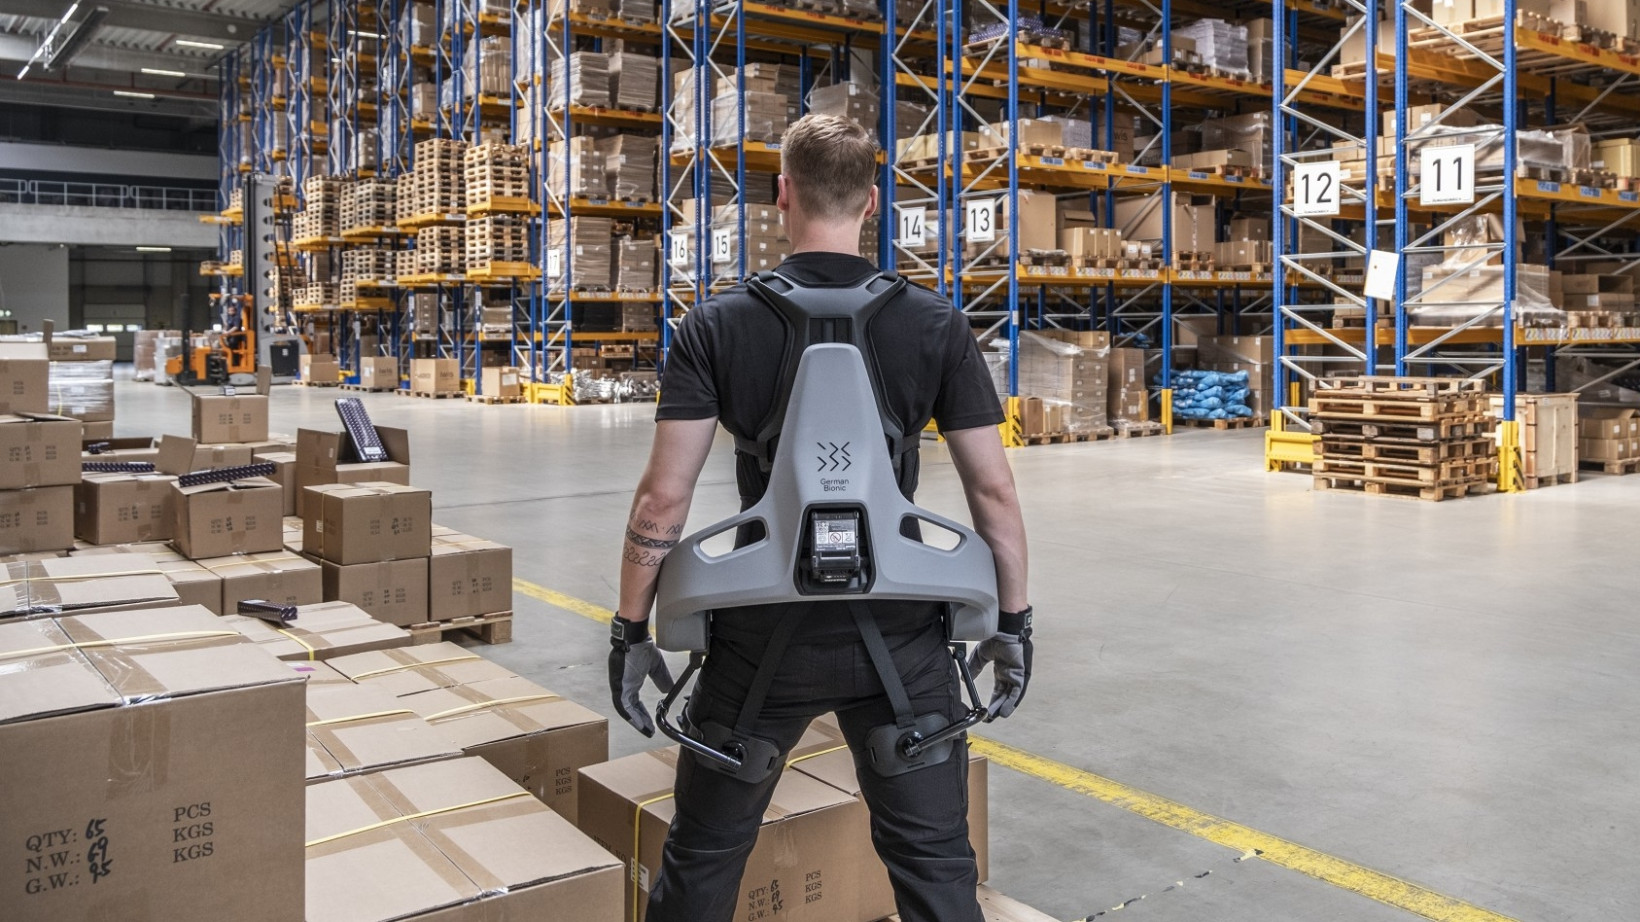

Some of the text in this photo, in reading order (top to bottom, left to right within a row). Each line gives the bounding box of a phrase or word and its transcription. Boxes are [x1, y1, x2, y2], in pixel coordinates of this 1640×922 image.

[1432, 156, 1462, 192] 11
[1301, 172, 1332, 204] 12
[903, 214, 921, 239] 14
[970, 207, 990, 233] 13
[673, 240, 686, 259] 16
[715, 234, 728, 255] 15
[555, 767, 571, 777] PCS
[555, 776, 572, 786] KGS
[555, 786, 572, 795] KGS
[25, 828, 77, 852] QTY:
[173, 802, 211, 822] PCS
[25, 851, 81, 873] N.W.:
[172, 822, 214, 843] KGS
[25, 872, 80, 895] G.W.:
[172, 842, 214, 863] KGS
[748, 886, 769, 900] QTY:
[805, 870, 821, 881] PCS
[805, 881, 822, 893] KGS
[805, 892, 822, 904] KGS
